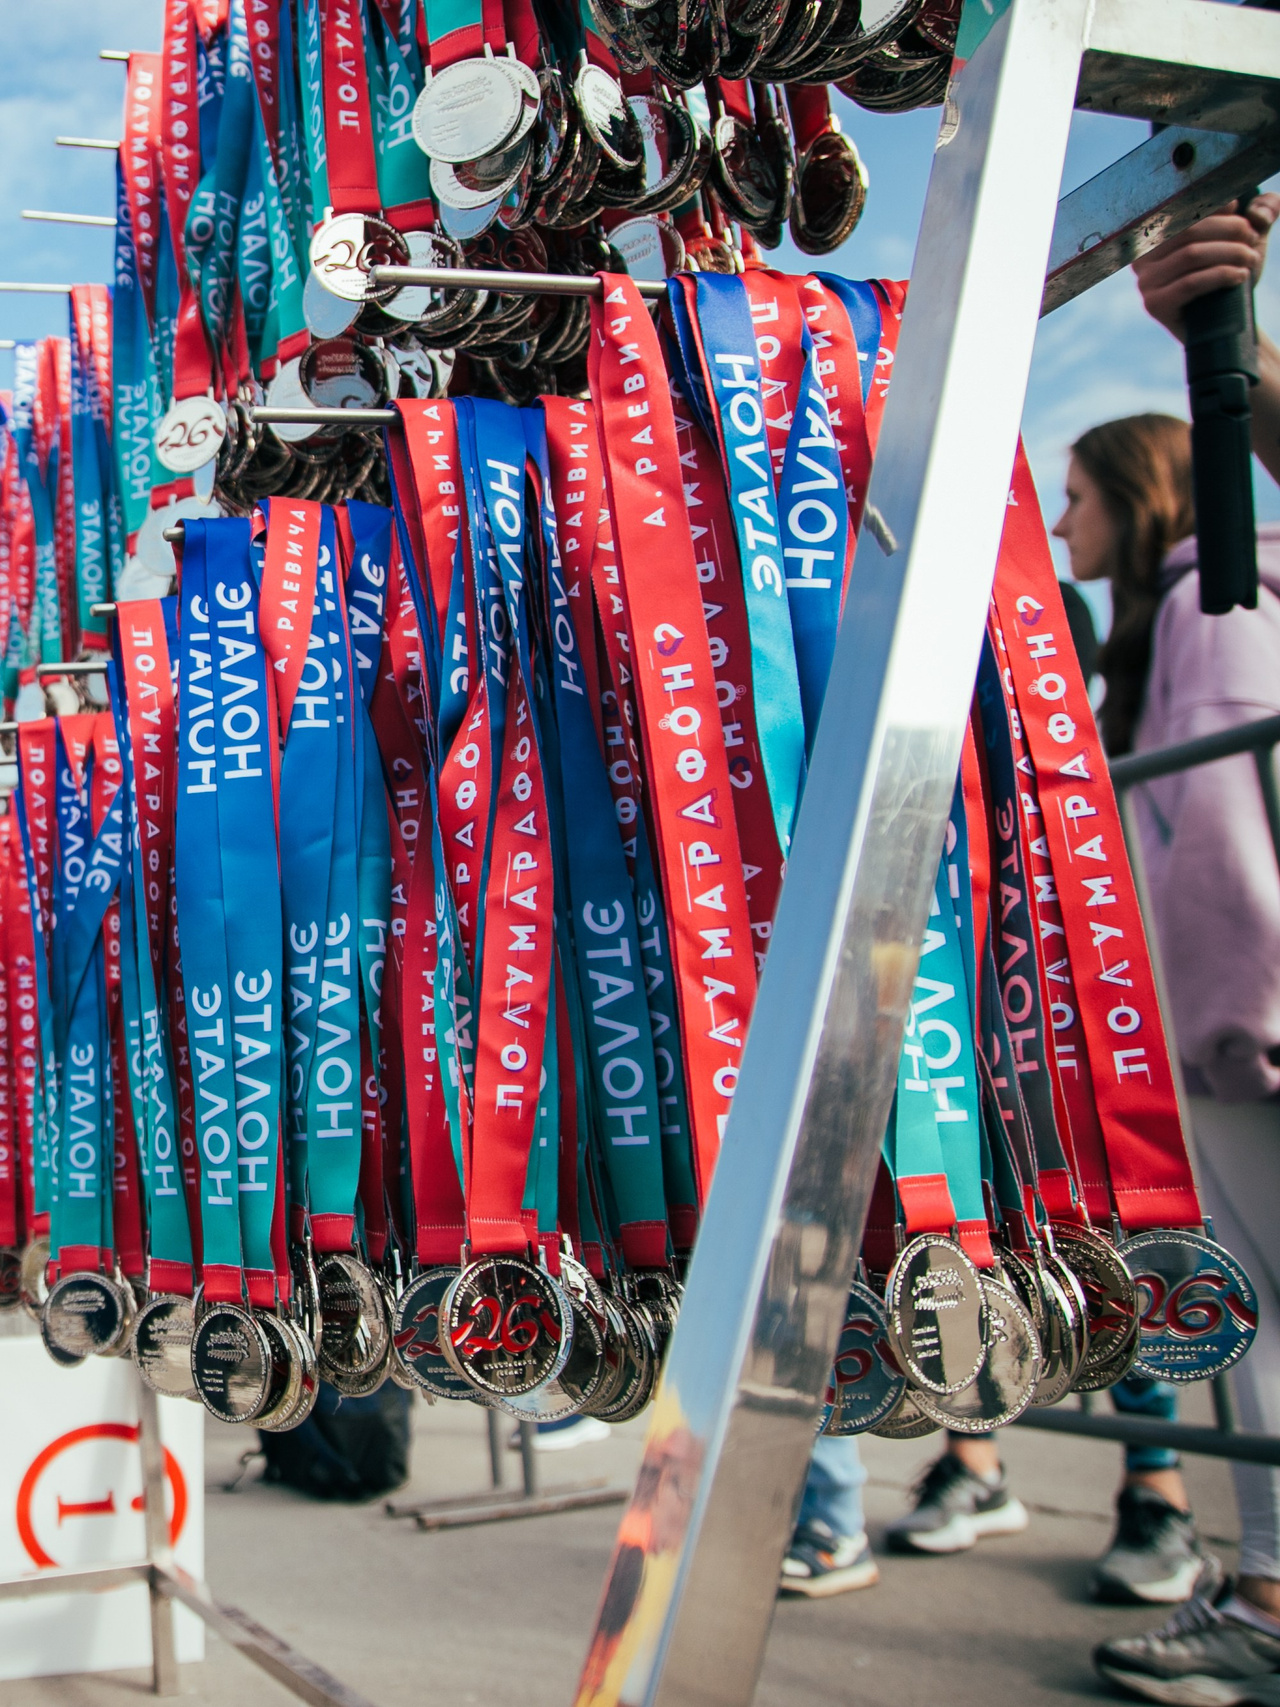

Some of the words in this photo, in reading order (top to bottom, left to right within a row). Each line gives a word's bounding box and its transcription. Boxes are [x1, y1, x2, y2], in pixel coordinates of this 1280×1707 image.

[129, 379, 151, 499] ЭТАЛОН
[164, 415, 213, 453] 26
[422, 404, 460, 566] АЕВИЧА
[565, 401, 588, 553] РАЕВИЧА
[606, 286, 659, 477] РАЕВИЧА
[714, 353, 784, 598] ЭТАЛОН
[37, 540, 59, 641] ЭТАЛОН
[81, 500, 104, 603] ЭТАЛОН
[276, 509, 307, 632] РАЕВИЧА
[131, 625, 162, 929] ПОЛУМАРАФОН
[215, 582, 263, 780] ЭТАЛОН
[495, 698, 541, 1116] ПОЛУМАРАФОН
[994, 796, 1041, 1074] ЭТАЛОН
[1025, 632, 1152, 1083] ПОЛУМАРАФОН
[191, 983, 233, 1206] ЭТАЛОН
[234, 968, 272, 1191] ЭТАЛОН
[289, 920, 319, 1142] ЭТАЛОН
[316, 912, 354, 1139] ЭТАЛОН
[582, 899, 651, 1147] ЭТАЛОН
[636, 888, 682, 1135] ЭТАЛОН
[69, 1043, 97, 1198] ЭТАЛОН
[462, 1294, 543, 1357] 26
